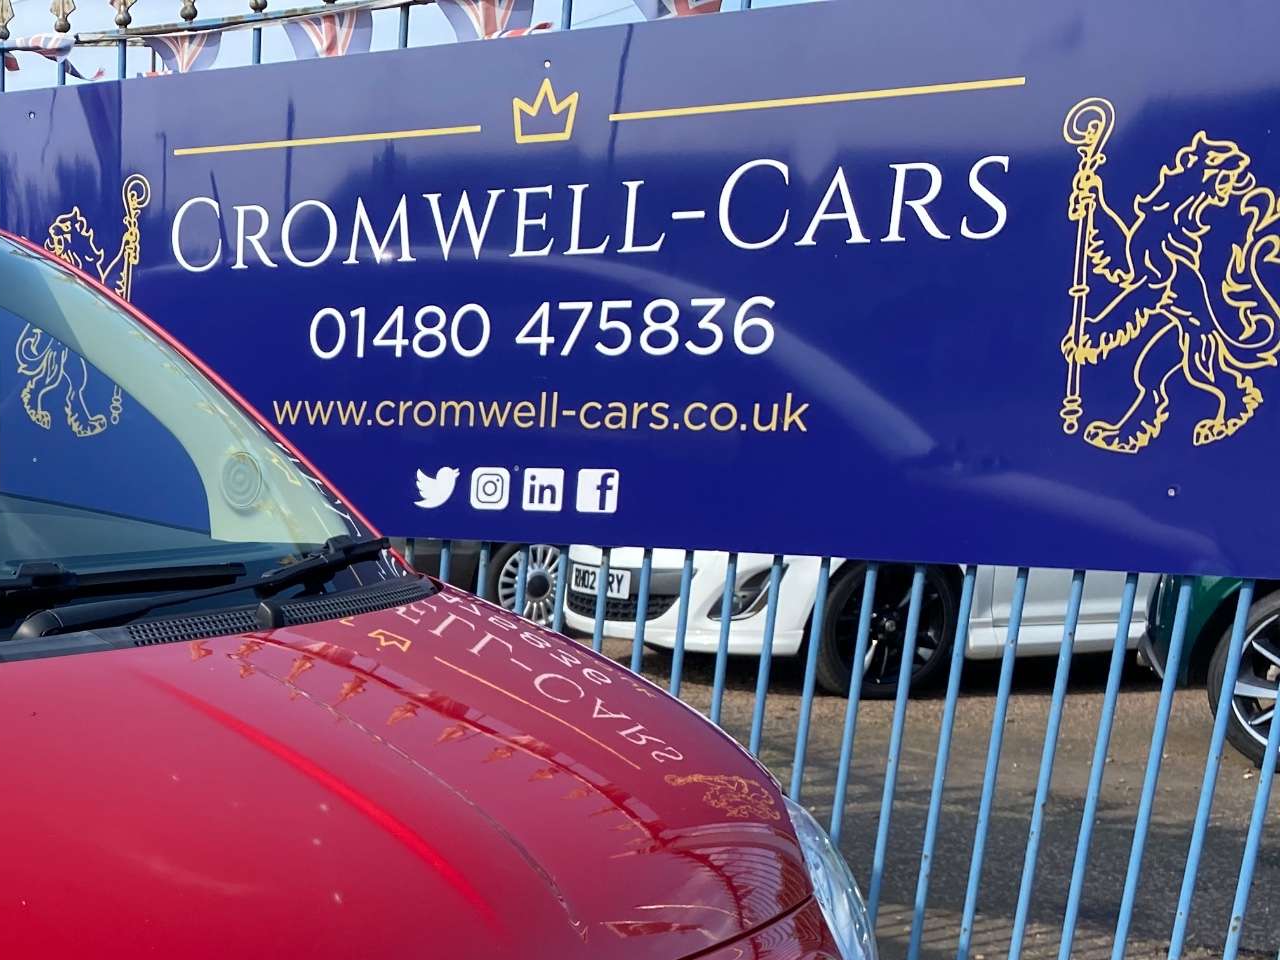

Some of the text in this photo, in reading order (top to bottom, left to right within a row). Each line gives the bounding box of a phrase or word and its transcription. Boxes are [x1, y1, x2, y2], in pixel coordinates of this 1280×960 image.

[170, 154, 1011, 272] CROMWELL-CARS
[309, 296, 777, 360] 01480 475836
[271, 393, 810, 435] www.cromwell-cars.co.uk
